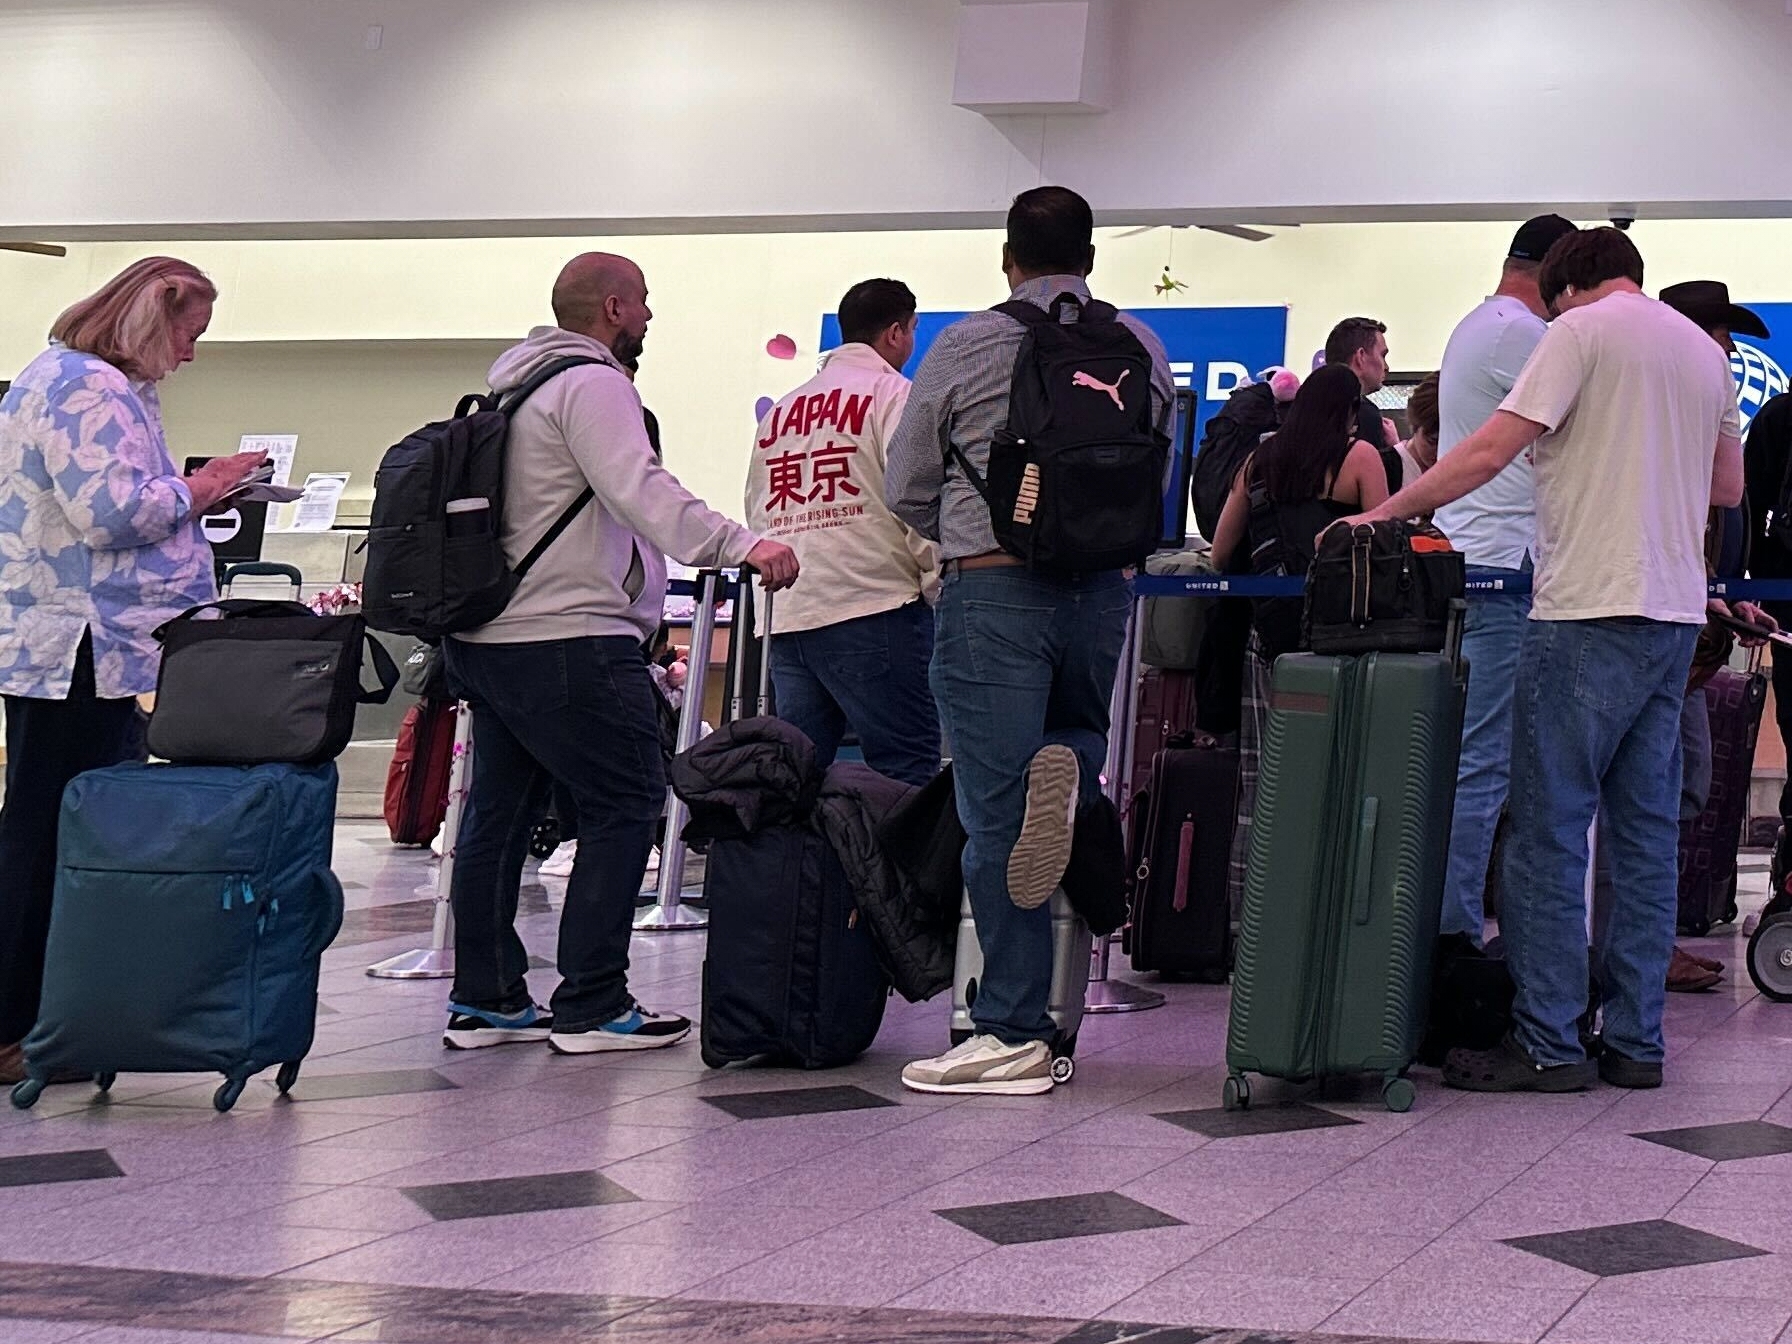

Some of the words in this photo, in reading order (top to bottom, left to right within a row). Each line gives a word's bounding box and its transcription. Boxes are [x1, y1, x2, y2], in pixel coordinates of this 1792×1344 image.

[758, 388, 873, 449] JAPAN
[764, 440, 861, 513] 東京
[1012, 462, 1041, 525] PUMA
[783, 516, 794, 527] OF
[807, 508, 839, 522] RISING
[841, 505, 864, 517] SUN
[1465, 581, 1493, 589] NITED
